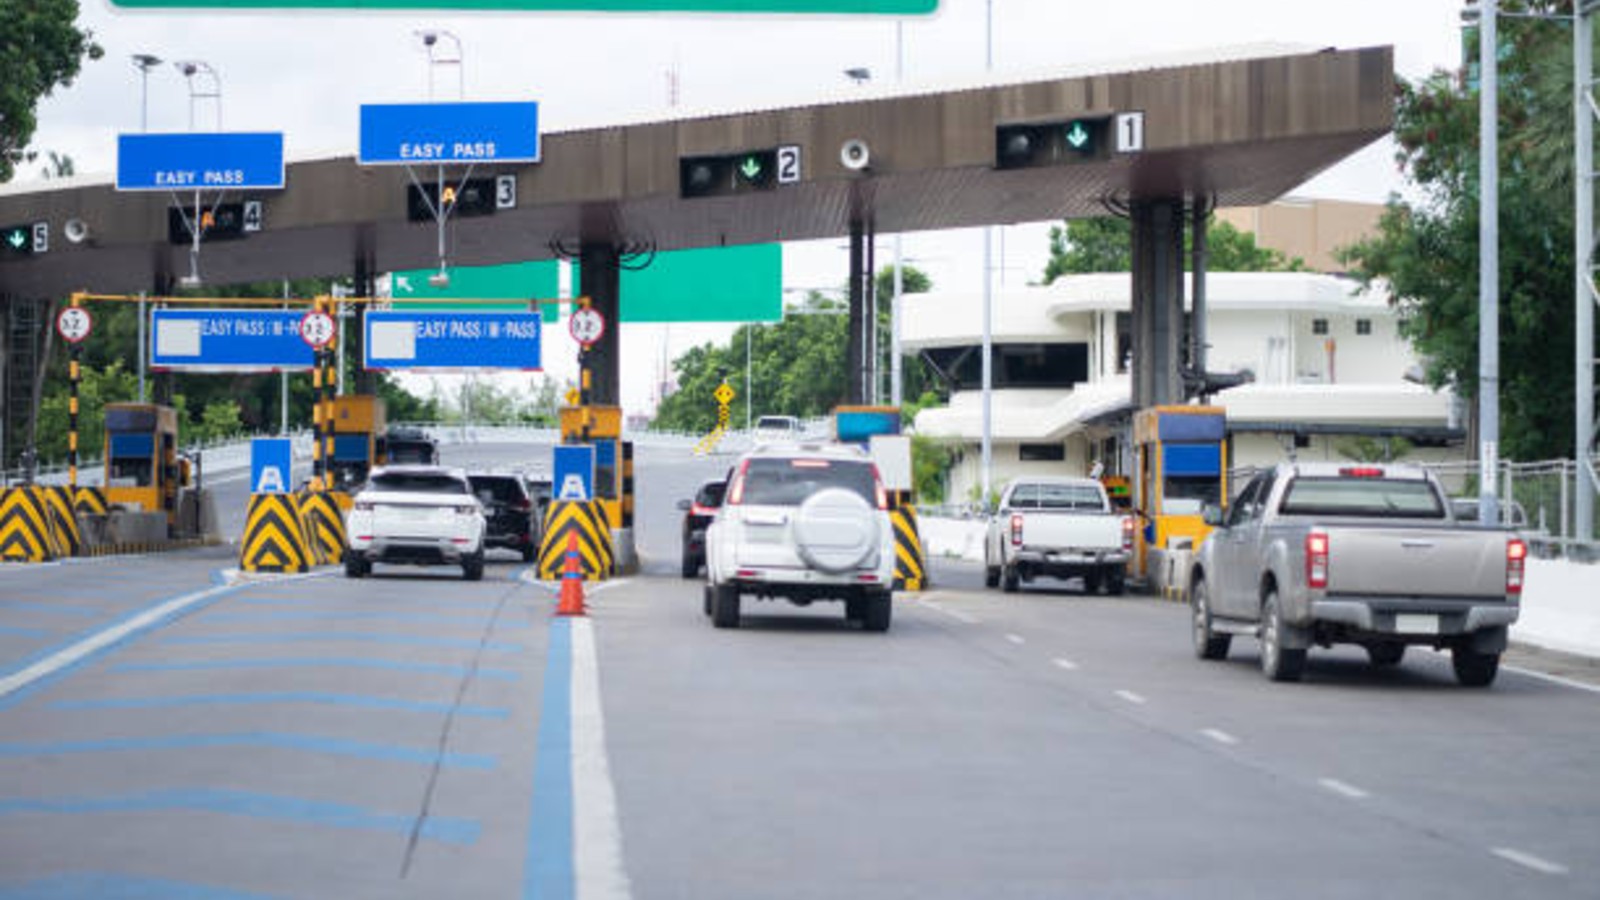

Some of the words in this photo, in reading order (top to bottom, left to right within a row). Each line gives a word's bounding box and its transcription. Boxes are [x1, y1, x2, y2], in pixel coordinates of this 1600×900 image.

[400, 143, 445, 158] EASY
[453, 143, 496, 158] PASS
[781, 151, 796, 178] 2
[156, 171, 196, 185] EASY
[203, 170, 245, 184] PASS
[499, 179, 512, 204] 3
[246, 204, 260, 225] 4
[36, 227, 46, 249] 5
[202, 319, 234, 336] EASY
[235, 319, 265, 336] PASS
[417, 321, 448, 338] EASY
[449, 321, 481, 339] PASS
[257, 466, 286, 494] A
[558, 474, 588, 501] A
